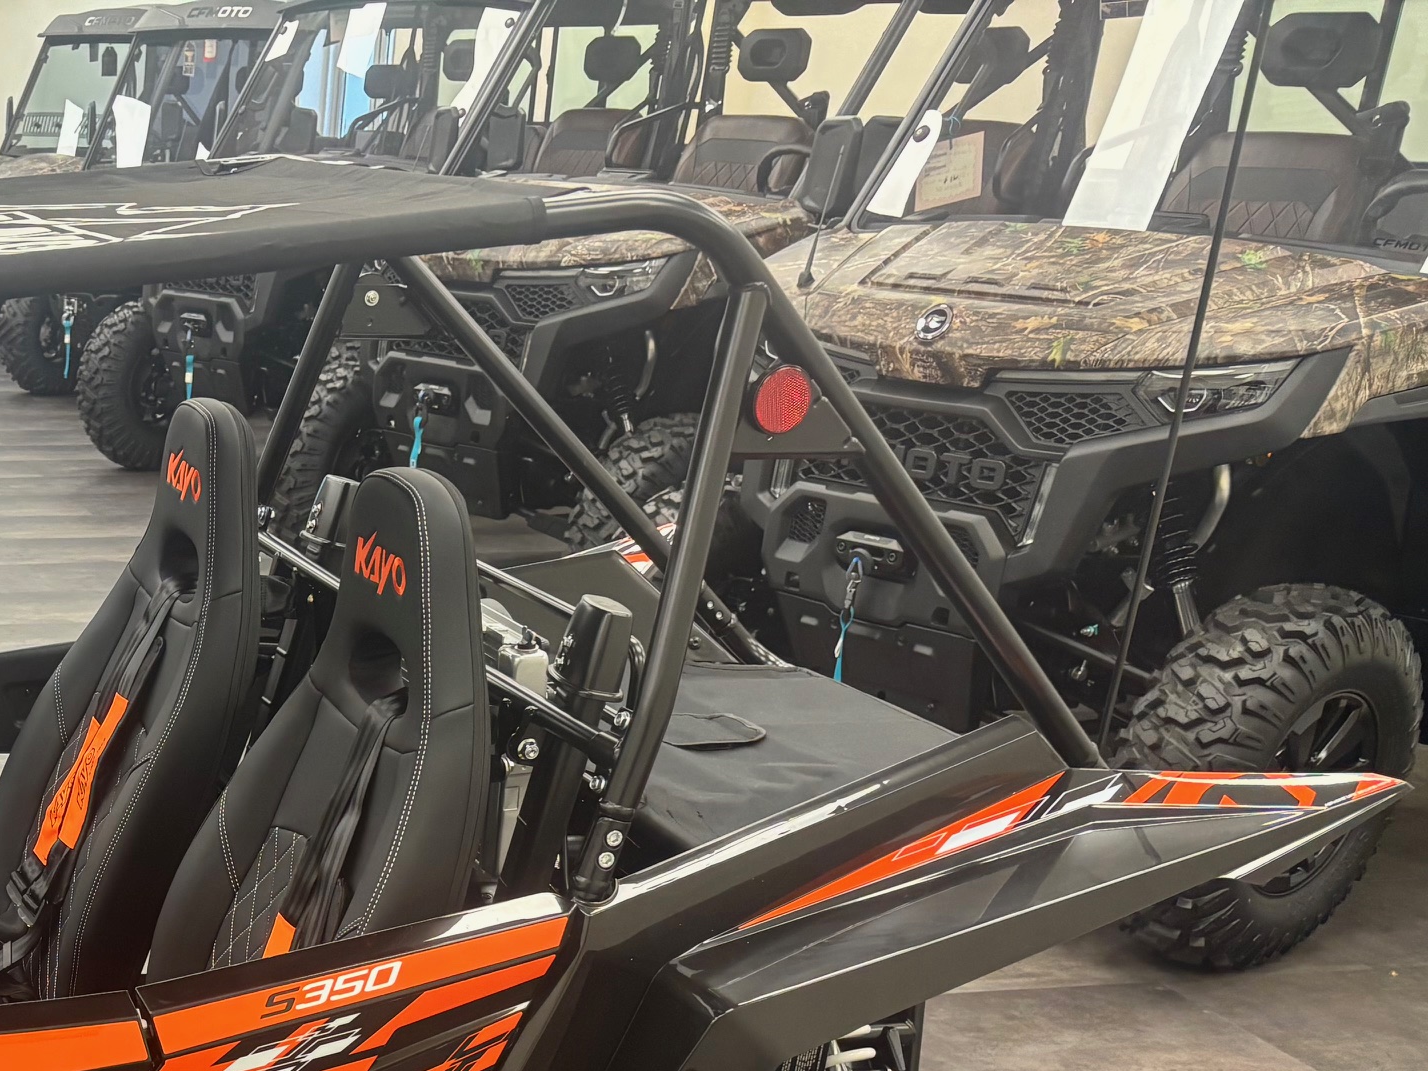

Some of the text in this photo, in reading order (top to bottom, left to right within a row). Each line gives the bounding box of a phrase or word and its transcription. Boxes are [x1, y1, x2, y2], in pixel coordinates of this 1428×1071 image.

[187, 6, 253, 19] CFMOTO
[166, 449, 202, 503] KAYO
[354, 531, 407, 596] KAYO
[260, 961, 403, 1020] S350
